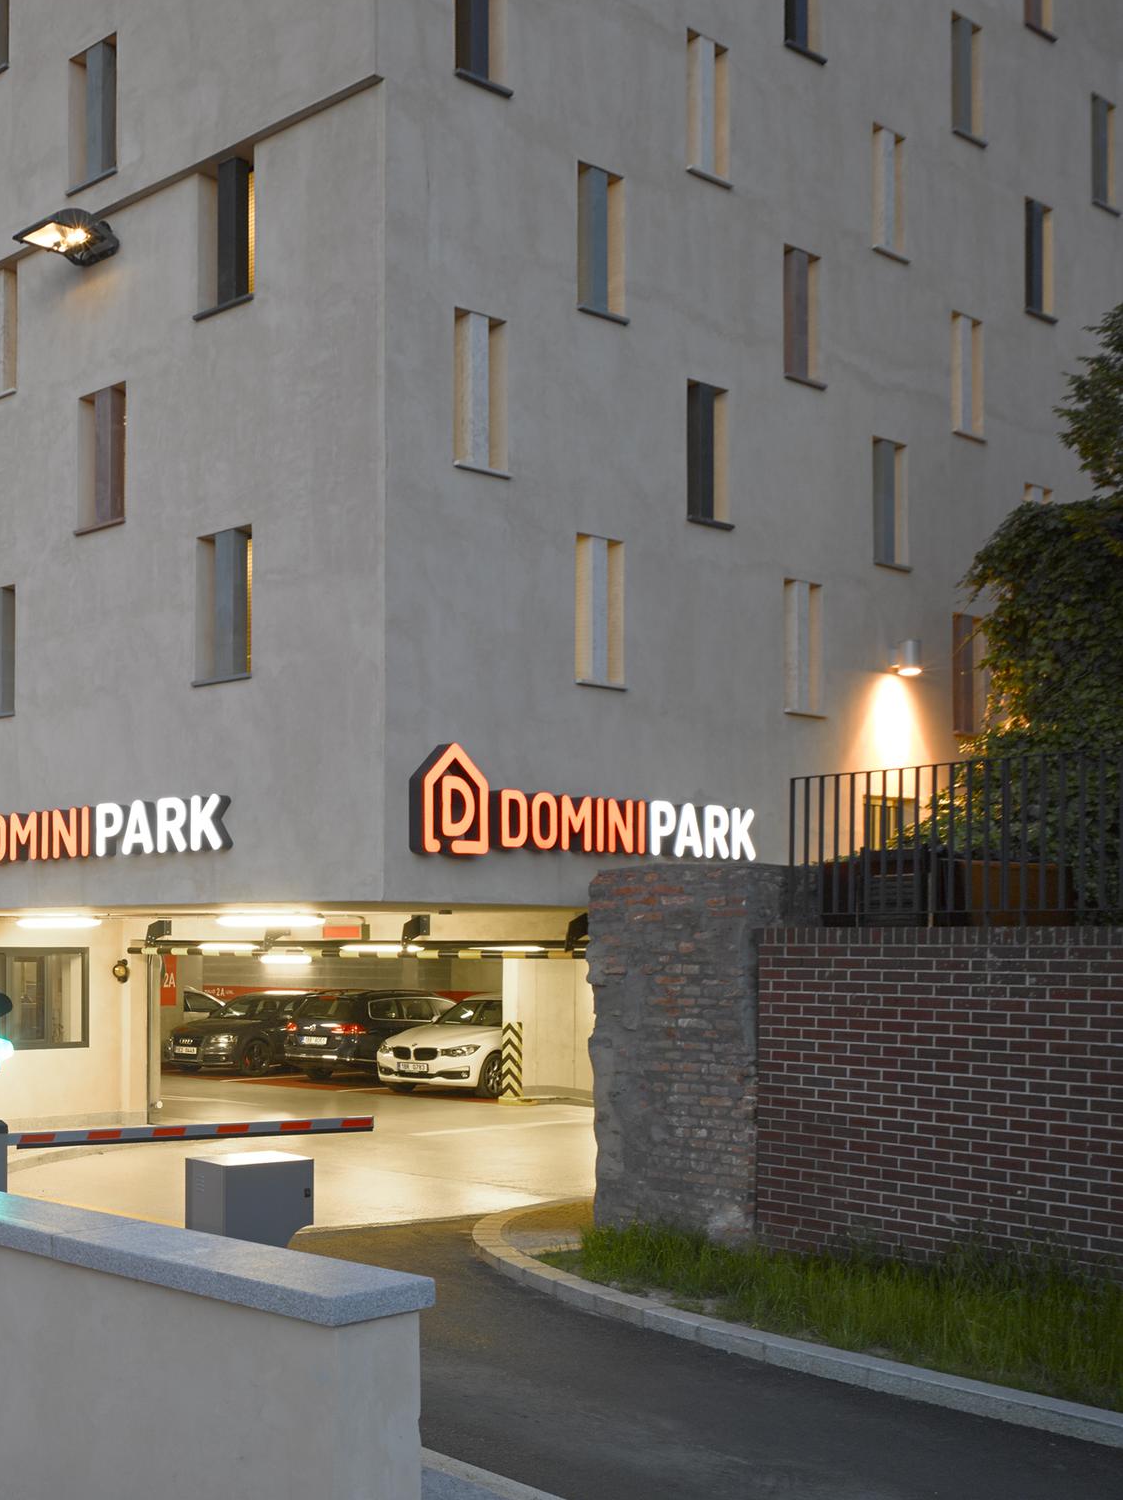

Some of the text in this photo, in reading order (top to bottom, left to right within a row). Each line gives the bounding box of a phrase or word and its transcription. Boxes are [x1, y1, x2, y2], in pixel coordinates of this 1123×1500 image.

[500, 788, 757, 861] DOMINIPARK
[163, 972, 176, 988] 2A
[216, 987, 226, 997] 2A
